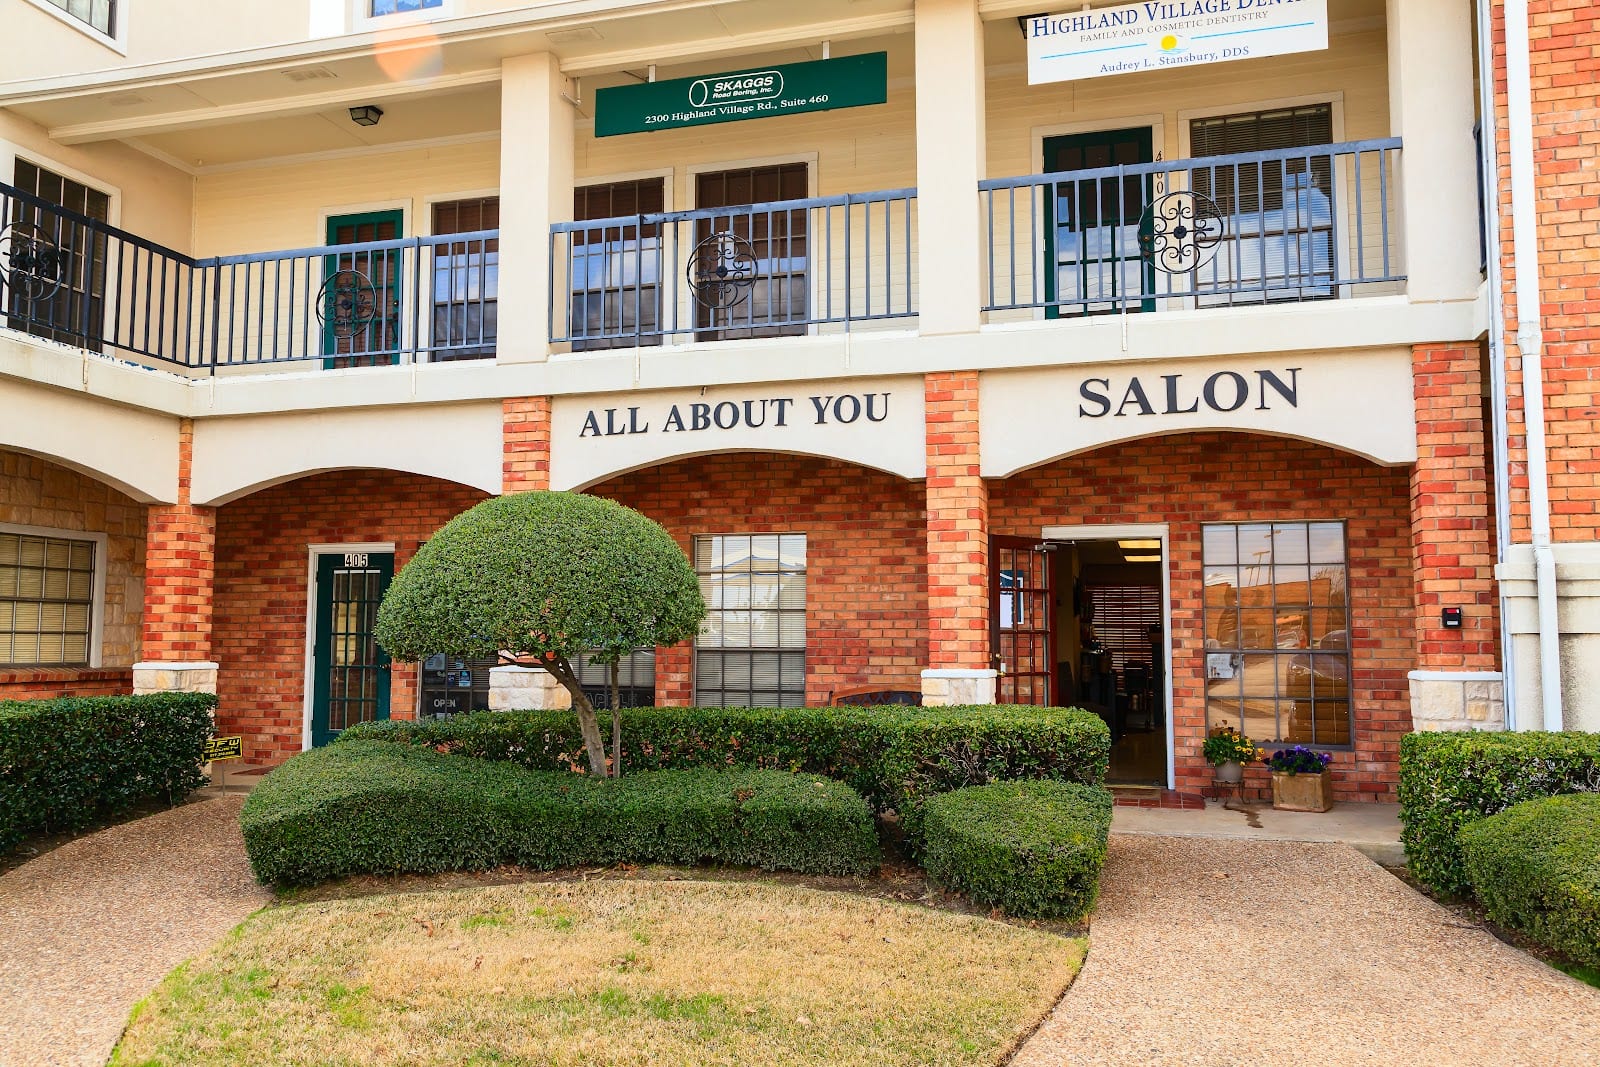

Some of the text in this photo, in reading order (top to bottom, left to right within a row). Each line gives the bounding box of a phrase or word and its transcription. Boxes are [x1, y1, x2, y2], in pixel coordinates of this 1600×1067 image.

[1032, 0, 1231, 37] HIGHLAND VILLAGE
[1079, 10, 1269, 43] FAMILY AND COSMETIC DENTISTRY
[1099, 46, 1250, 73] Audrey L. Stansbury, DDS
[712, 89, 731, 99] Road
[732, 86, 759, 97] Boring,
[713, 76, 774, 92] SKAGGS
[645, 94, 829, 124] 2300 Highland Village Rd., Suite 460
[1079, 367, 1302, 419] SALON
[579, 392, 891, 438] ALL ABOUT YOU
[345, 554, 368, 567] 405
